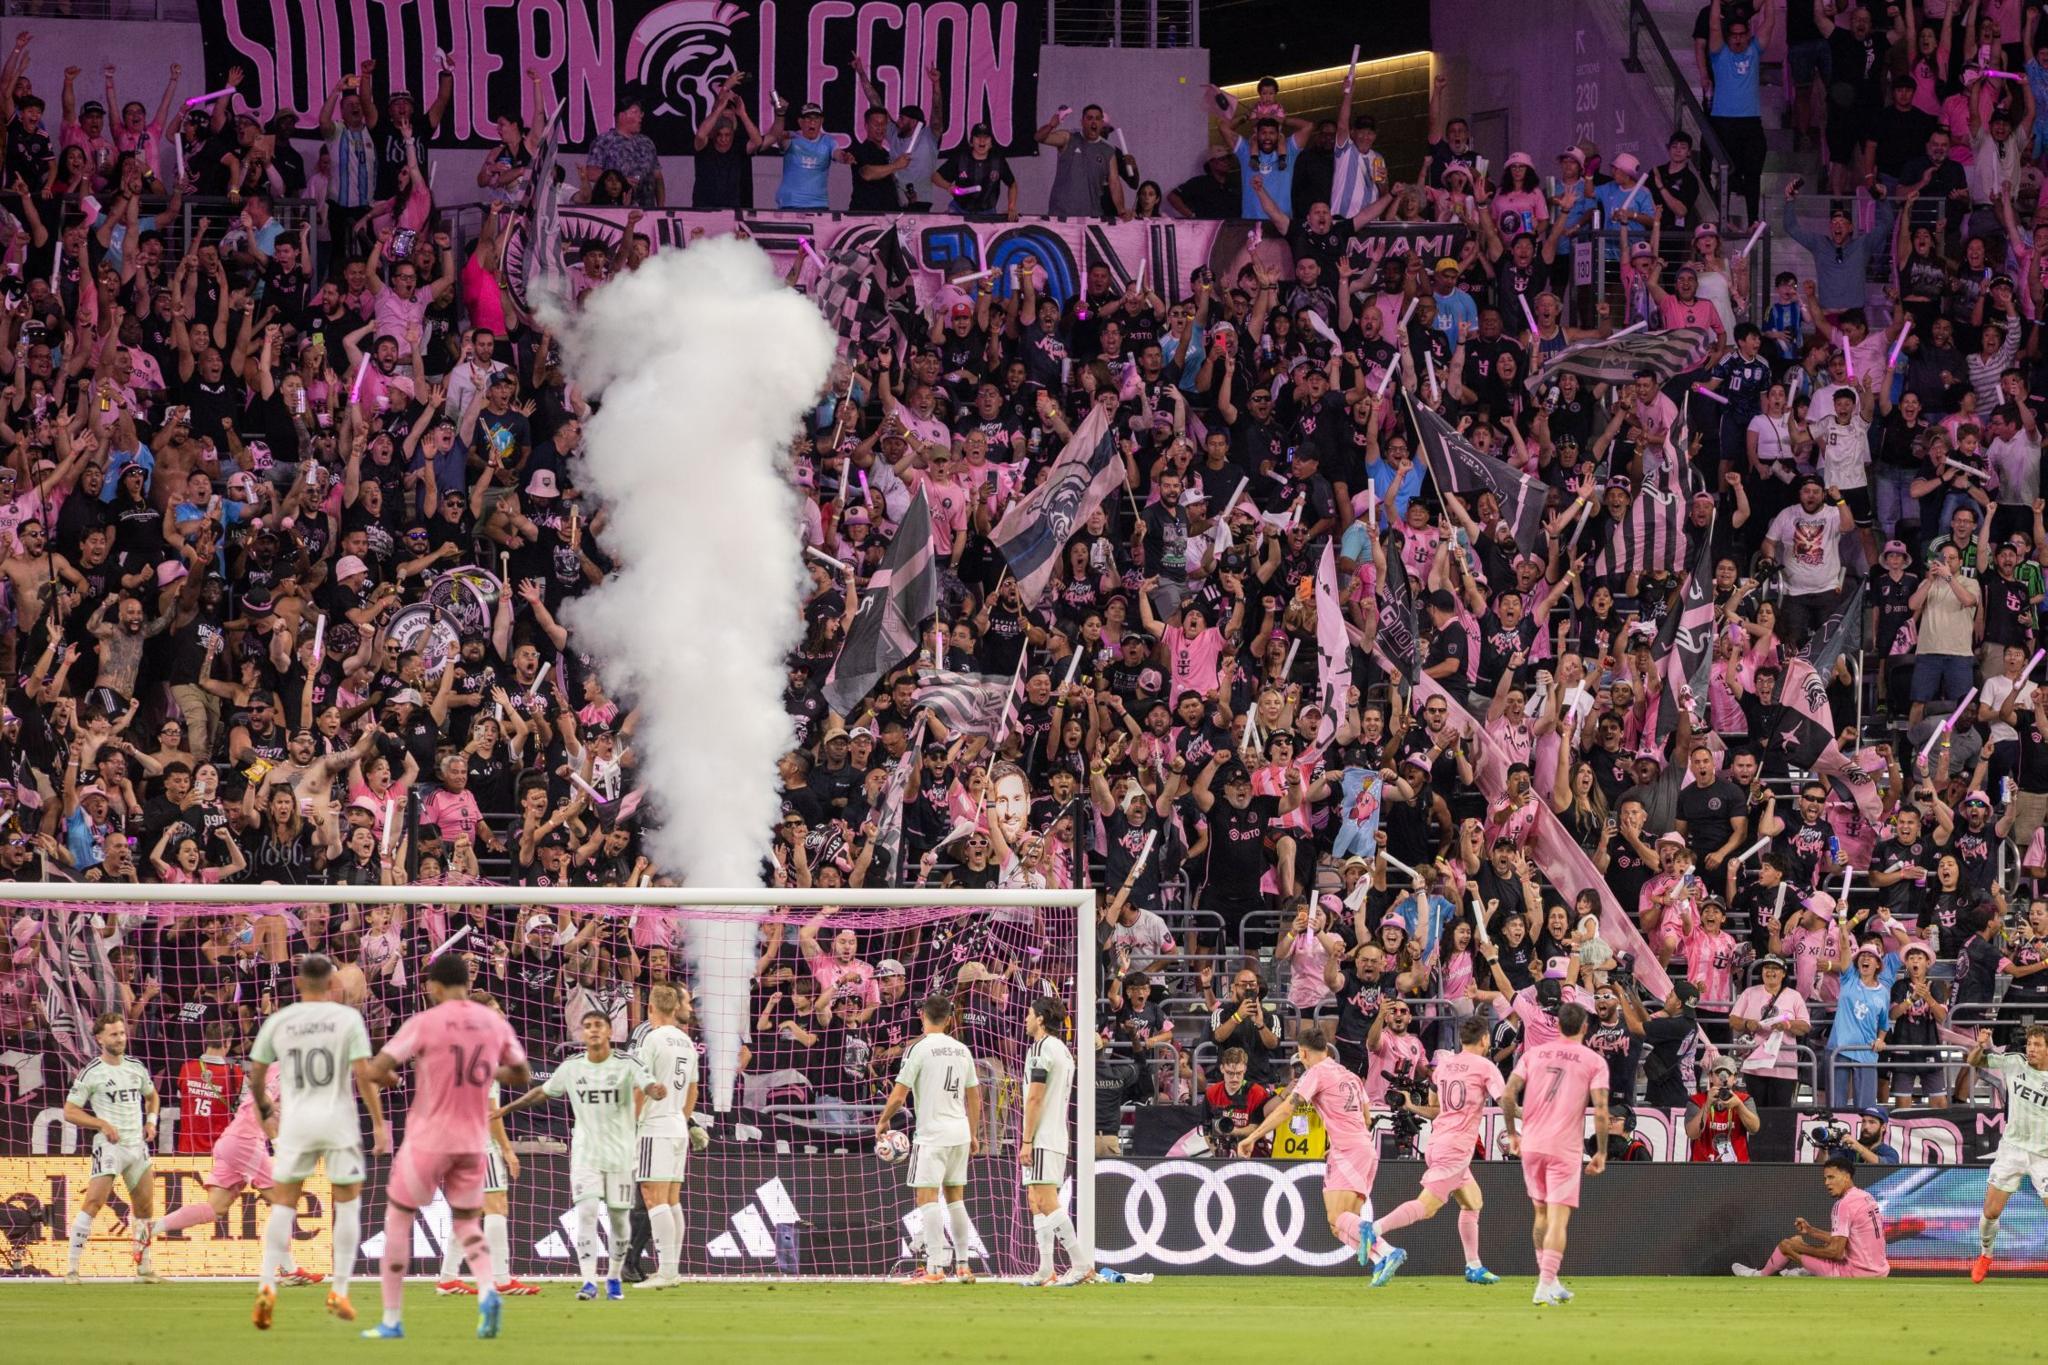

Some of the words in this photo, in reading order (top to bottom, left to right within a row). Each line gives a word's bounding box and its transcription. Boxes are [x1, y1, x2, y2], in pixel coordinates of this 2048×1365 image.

[222, 0, 615, 144] SOUTHERN
[759, 0, 1018, 150] LEGION
[1576, 83, 1598, 111] 230
[1577, 261, 1591, 281] 130
[1729, 375, 1742, 391] 10
[402, 616, 432, 632] BAND
[1240, 828, 1260, 841] XBTO
[450, 1043, 492, 1088] 16
[1538, 1051, 1554, 1060] DE
[1556, 1051, 1581, 1064] PAUL
[287, 1047, 335, 1090] 10
[673, 1057, 688, 1101] 5
[943, 1064, 960, 1099] 4
[1095, 1080, 1123, 1089] ARDIAN
[1546, 1066, 1567, 1103] 7
[105, 1088, 138, 1104] YET
[576, 1089, 620, 1104] YETI
[1440, 1079, 1467, 1112] 10
[194, 1097, 212, 1117] 15
[1285, 1138, 1310, 1156] 04
[619, 1184, 631, 1203] 11
